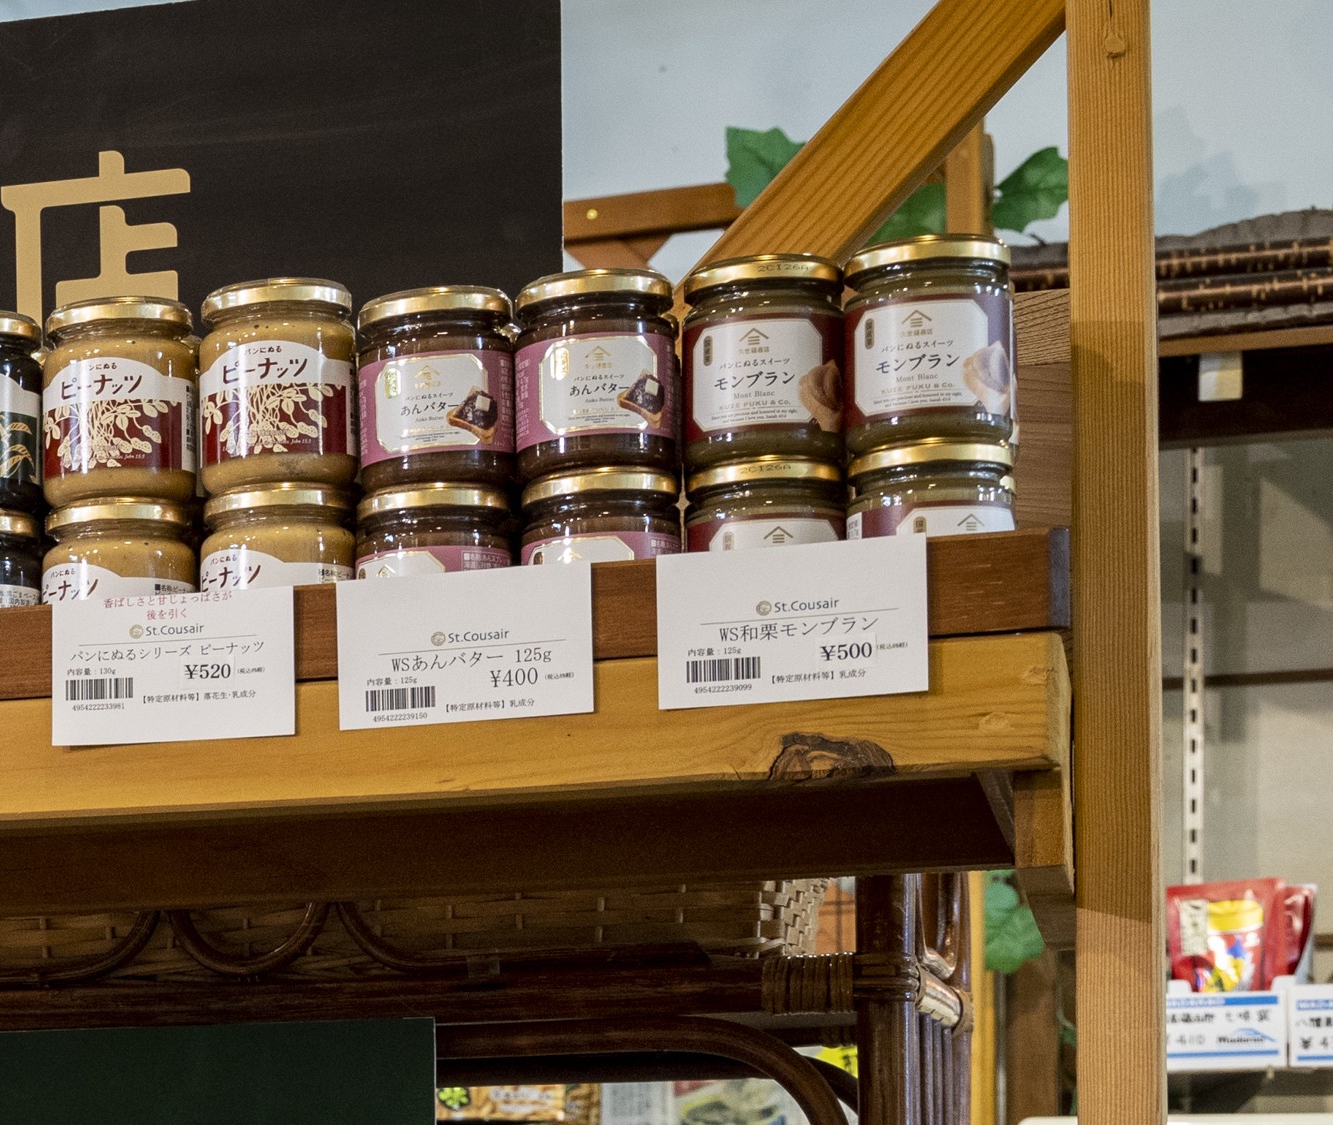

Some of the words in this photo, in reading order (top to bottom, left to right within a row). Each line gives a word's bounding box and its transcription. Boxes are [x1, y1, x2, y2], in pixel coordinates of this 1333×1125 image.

[222, 358, 308, 385] ピーナッツ
[719, 357, 791, 370] パンにぬるスイーツ
[875, 354, 960, 374] モンブラン
[61, 374, 143, 400] ピーナッツ
[569, 382, 630, 397] あんバター
[714, 371, 796, 391] モンブラン
[733, 390, 755, 399] Mont
[757, 389, 775, 398] Blanc
[400, 401, 460, 416] あんバター
[774, 598, 840, 613] St.Cousair
[146, 609, 188, 620] 後を引く
[146, 623, 204, 636] St.Cousair
[448, 628, 509, 643] St.Cousair
[719, 616, 879, 642] WS和栗モンブラン
[71, 644, 192, 662] パンにぬるシリーズ
[200, 640, 265, 656] ピーナッツ
[392, 653, 504, 672] WSあんバター
[516, 647, 552, 664] 125g
[821, 642, 873, 662] ¥500
[184, 664, 231, 679] ¥520
[490, 668, 538, 688] ¥400
